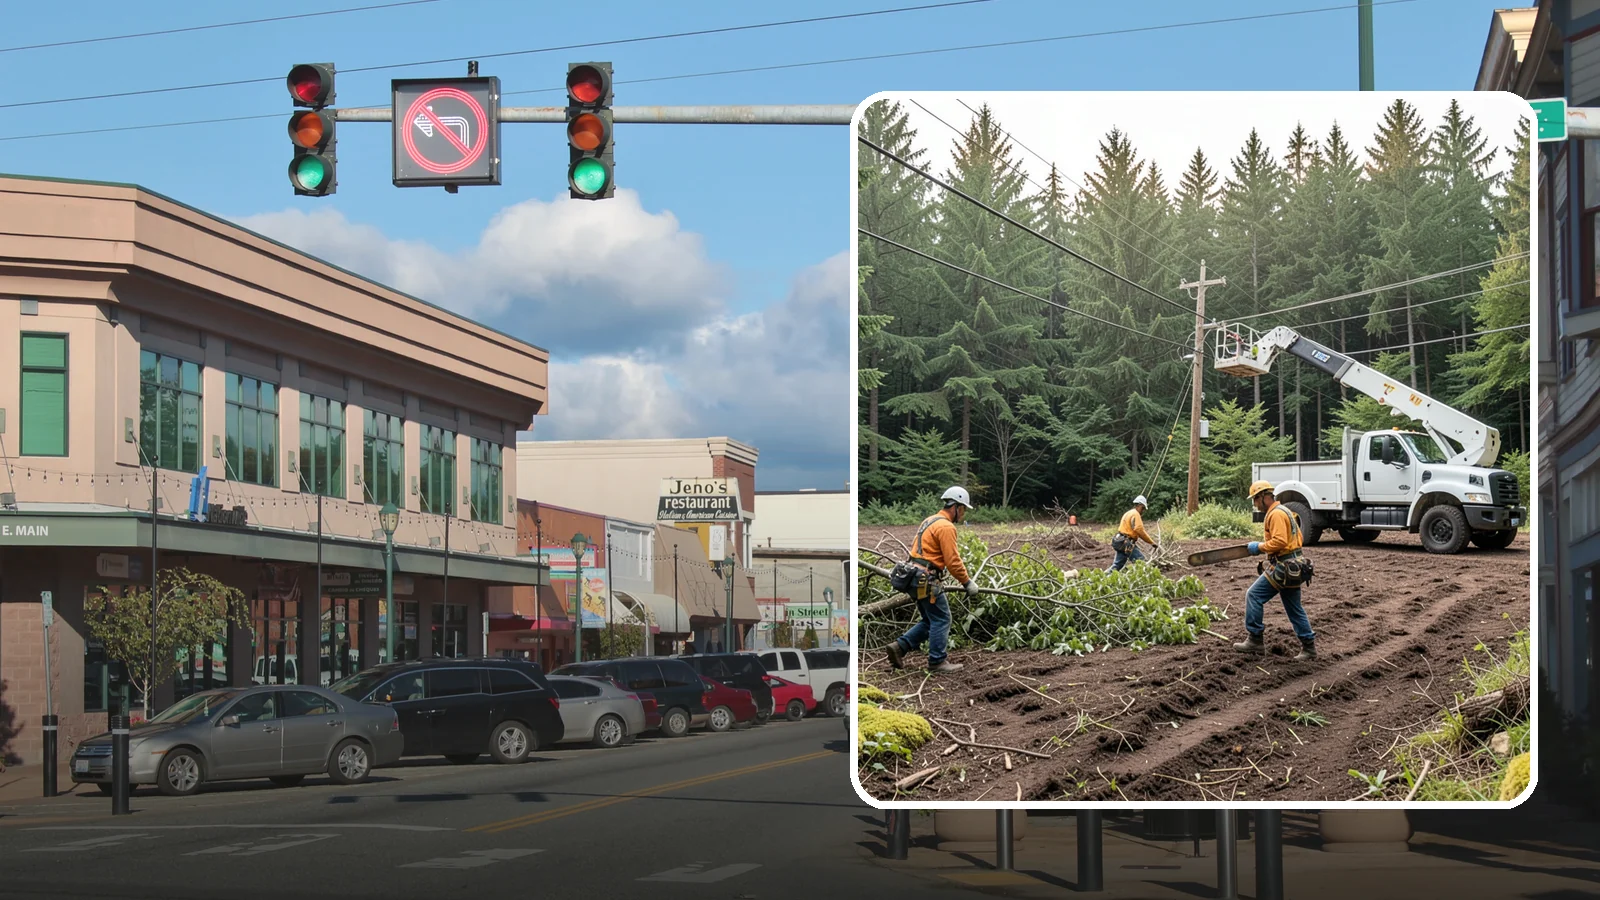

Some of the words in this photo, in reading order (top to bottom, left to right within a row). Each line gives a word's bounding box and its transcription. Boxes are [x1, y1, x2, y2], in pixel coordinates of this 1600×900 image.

[670, 480, 727, 494] Jeno's
[665, 497, 730, 508] restaurant
[659, 511, 681, 519] Italian
[686, 510, 714, 519] American
[715, 510, 737, 519] Cuisine
[2, 525, 13, 536] E.
[16, 525, 49, 536] MAIN
[797, 608, 828, 617] Street
